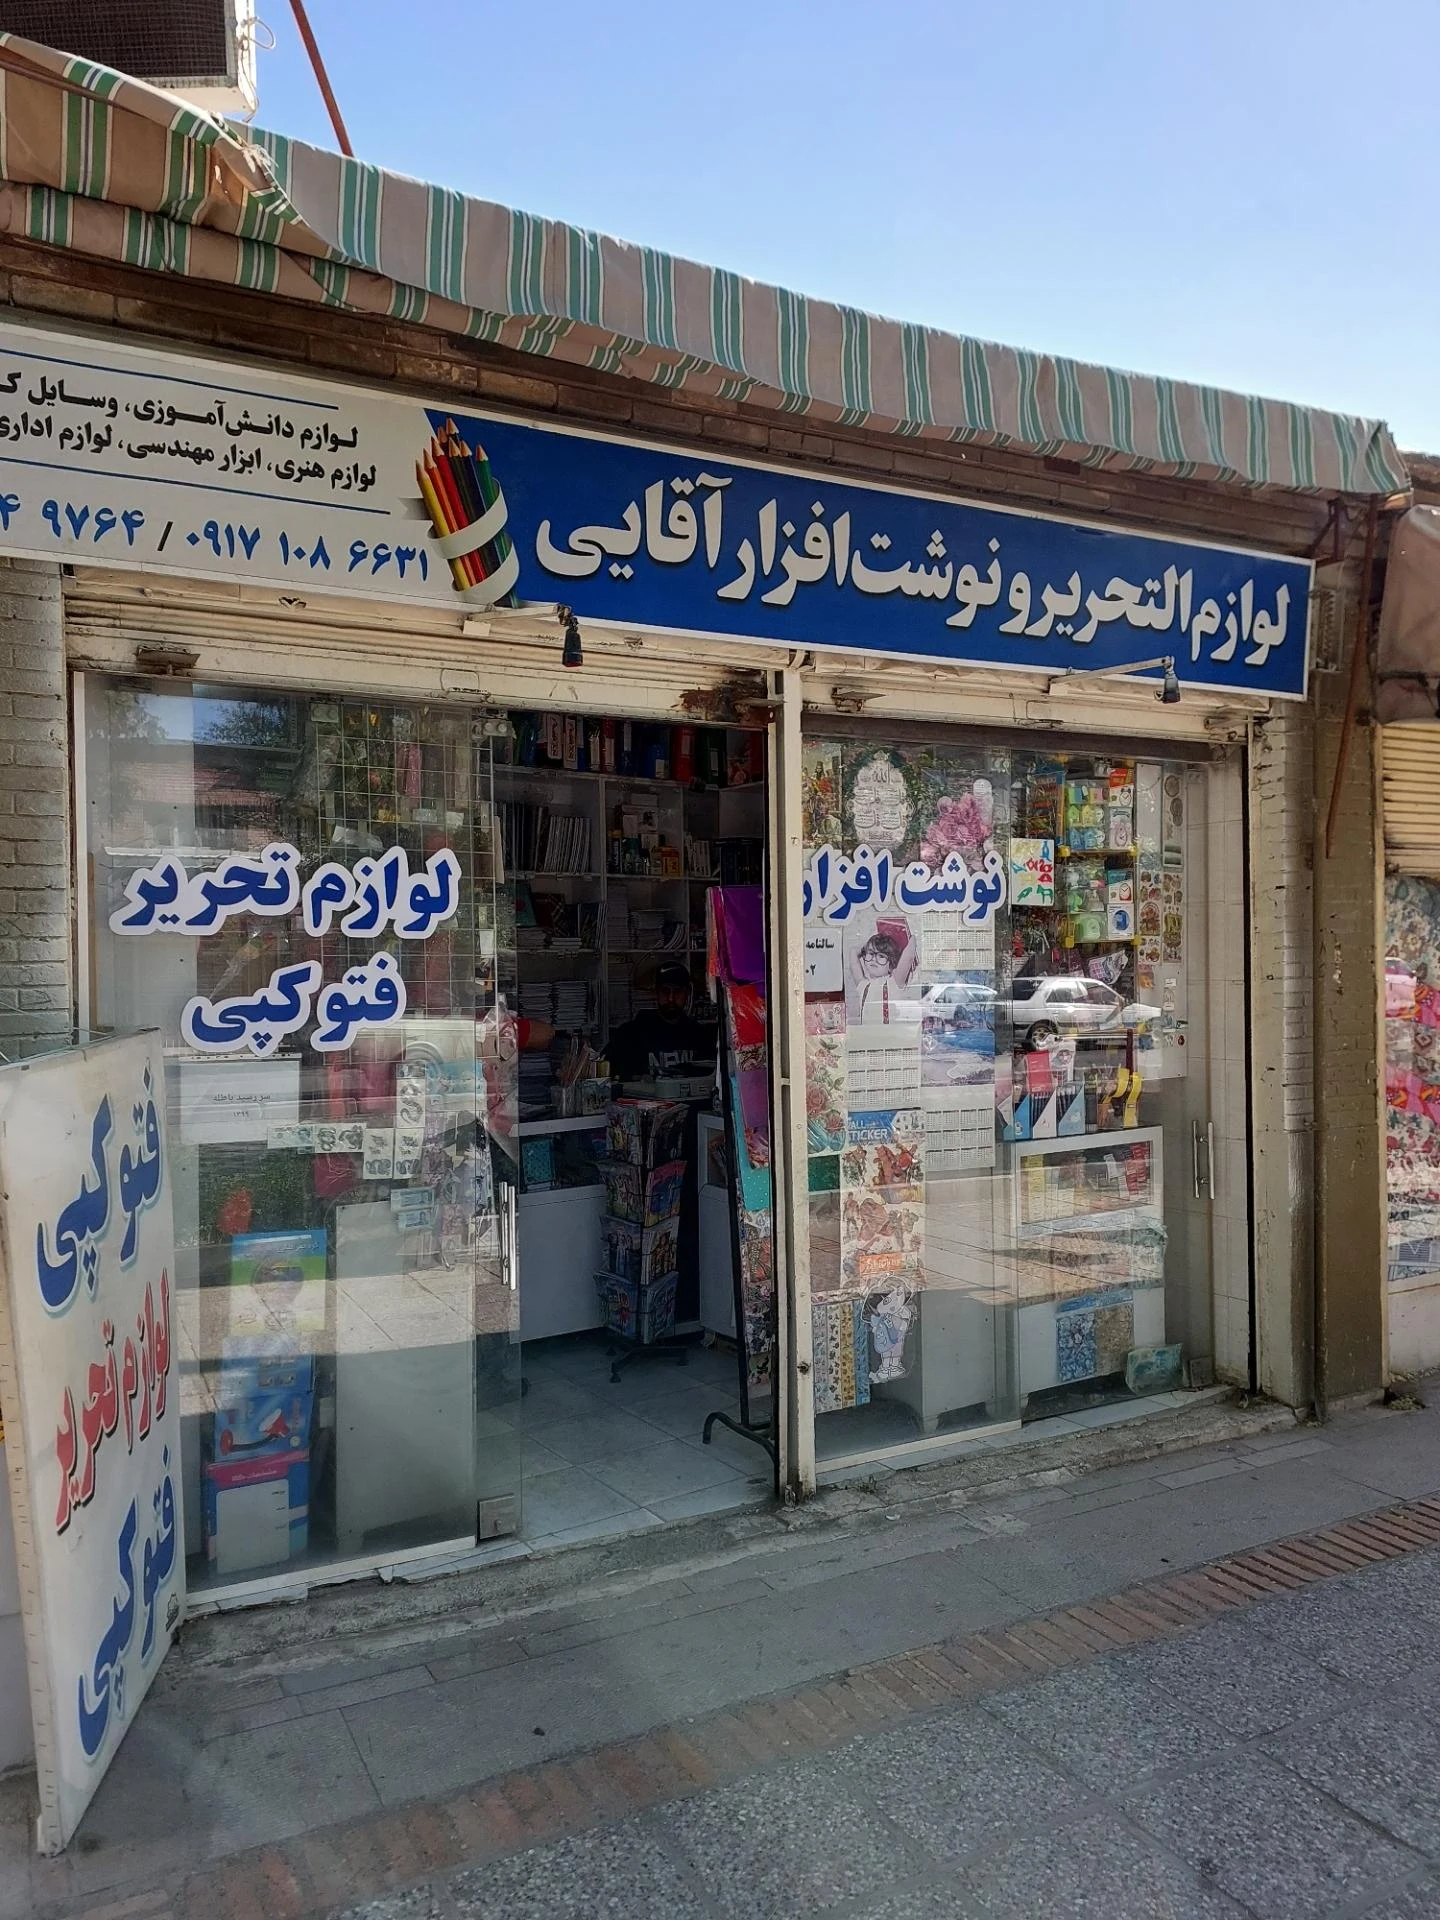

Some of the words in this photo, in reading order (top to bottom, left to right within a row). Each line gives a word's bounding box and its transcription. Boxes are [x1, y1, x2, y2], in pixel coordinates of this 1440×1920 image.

[27, 375, 119, 419] وسایل
[58, 420, 113, 454] لوازم
[217, 443, 262, 475] ابزار
[300, 422, 359, 453] لوازم
[330, 462, 377, 492] لوازم
[41, 499, 145, 547] ۹۷۶۴
[185, 519, 262, 561] ۰۹۱۷
[278, 530, 332, 571] ۱۰۸
[348, 539, 429, 582] ۶۶۳۱
[535, 471, 734, 580] آقایی
[120, 850, 292, 926] تحریر
[310, 855, 453, 932] لوازم
[899, 854, 1001, 920] نوشت
[805, 938, 835, 949] سالنامه
[122, 1267, 171, 1456] لوازم
[55, 1318, 120, 1535] تحریر
